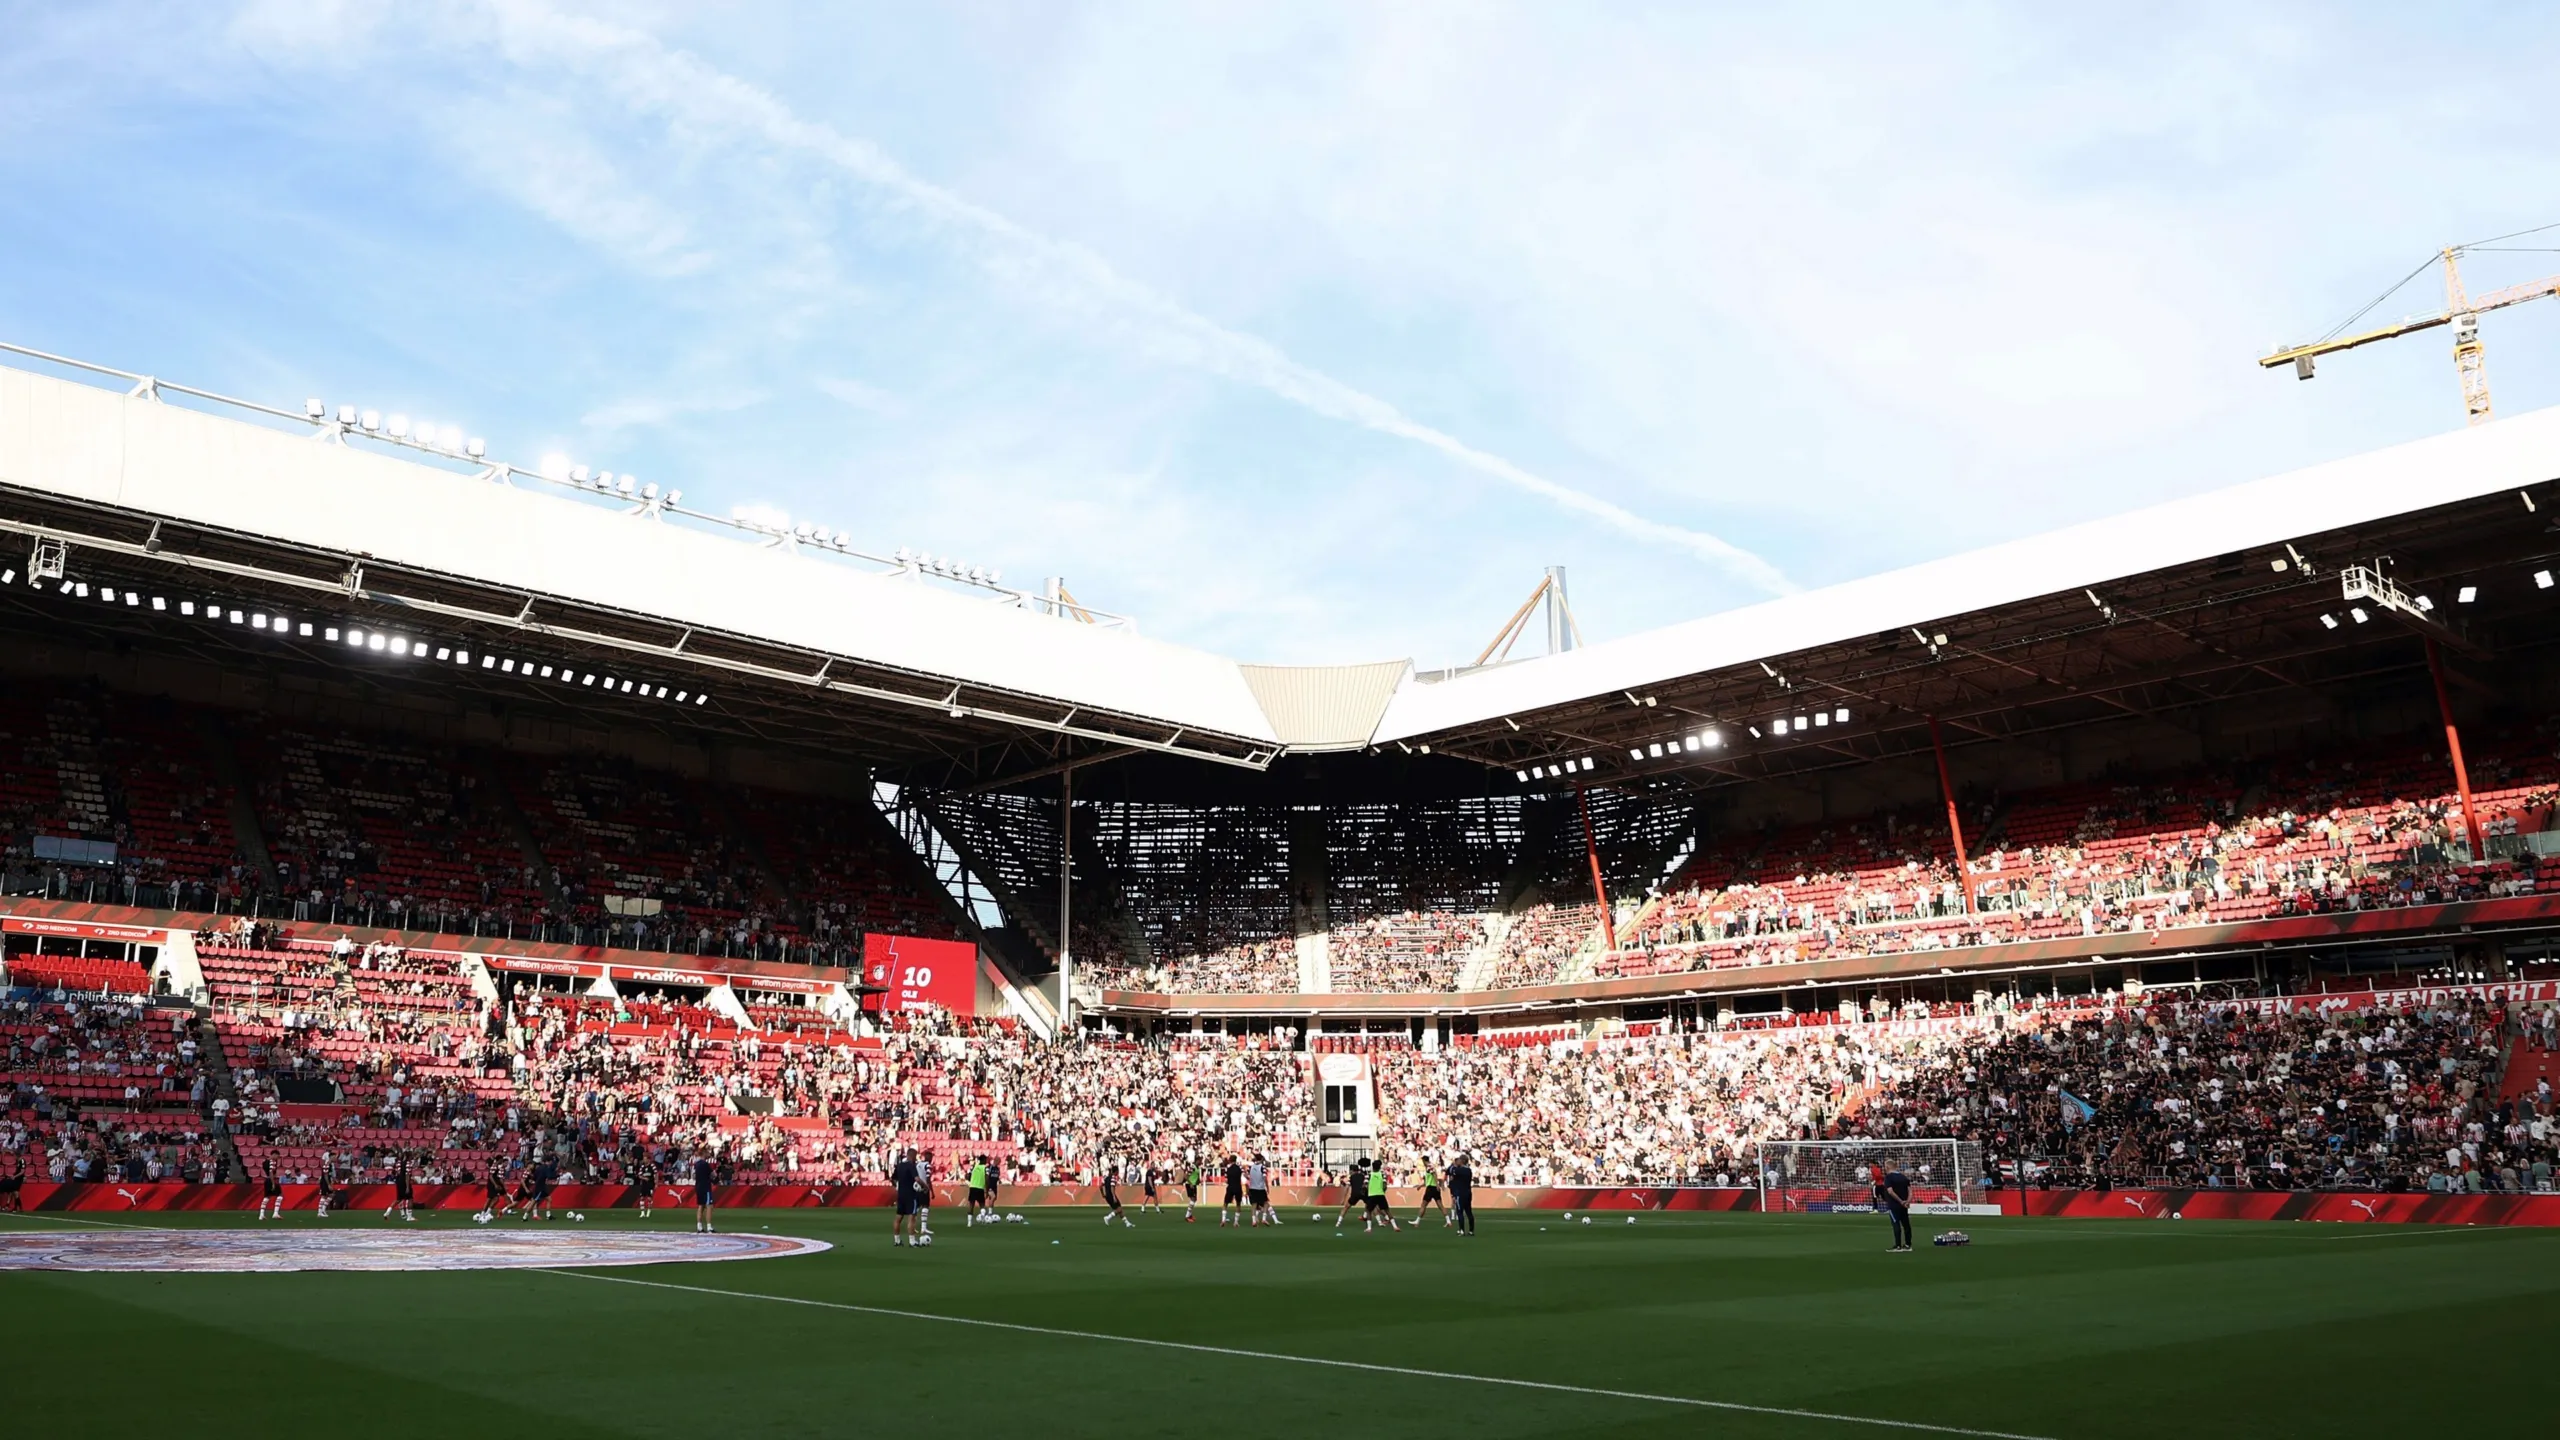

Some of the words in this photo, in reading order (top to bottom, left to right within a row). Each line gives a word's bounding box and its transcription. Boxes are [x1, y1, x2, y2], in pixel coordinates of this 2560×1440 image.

[541, 963, 579, 974] payrolling
[903, 966, 931, 987] 10
[781, 981, 815, 992] payrolling
[112, 994, 157, 1006] staon
[901, 990, 918, 999] OLE
[1832, 1204, 1874, 1214] goodhabitz
